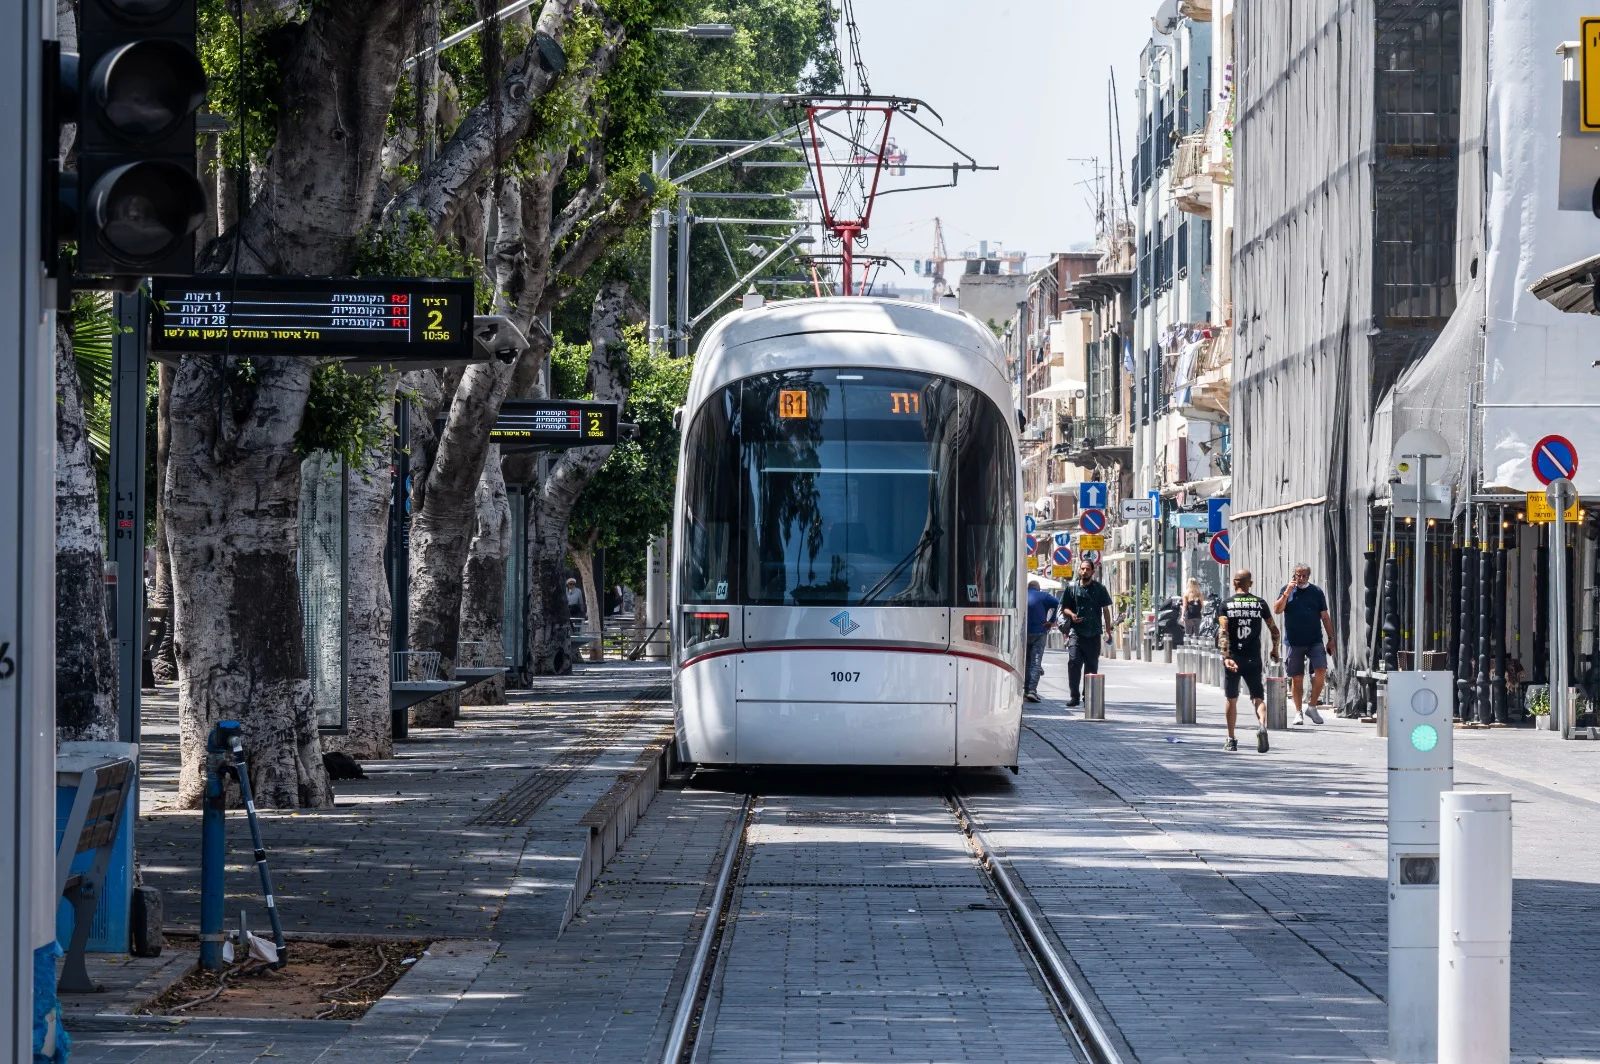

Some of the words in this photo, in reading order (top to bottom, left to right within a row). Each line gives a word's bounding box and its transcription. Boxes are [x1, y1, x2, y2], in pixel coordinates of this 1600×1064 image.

[184, 292, 212, 302] דקות
[215, 292, 221, 300] 1
[331, 294, 385, 304] הקוממיות
[391, 294, 408, 303] R2
[422, 298, 448, 306] רציף
[181, 305, 208, 314] דקות
[211, 304, 226, 313] 12
[331, 306, 385, 316] הקוממיות
[392, 306, 408, 315] R1
[181, 316, 208, 326] דקות
[211, 316, 226, 325] 28
[331, 318, 385, 328] הקוממיות
[392, 318, 408, 327] R1
[427, 310, 443, 330] 2
[188, 329, 199, 338] או
[203, 329, 228, 340] לעשן
[271, 330, 301, 339] איסור
[304, 330, 319, 339] חל
[422, 331, 450, 340] 10:56
[784, 393, 803, 415] R1
[590, 419, 600, 431] 2
[969, 587, 978, 598] 04
[1237, 626, 1252, 639] UP
[830, 671, 861, 683] 1007
